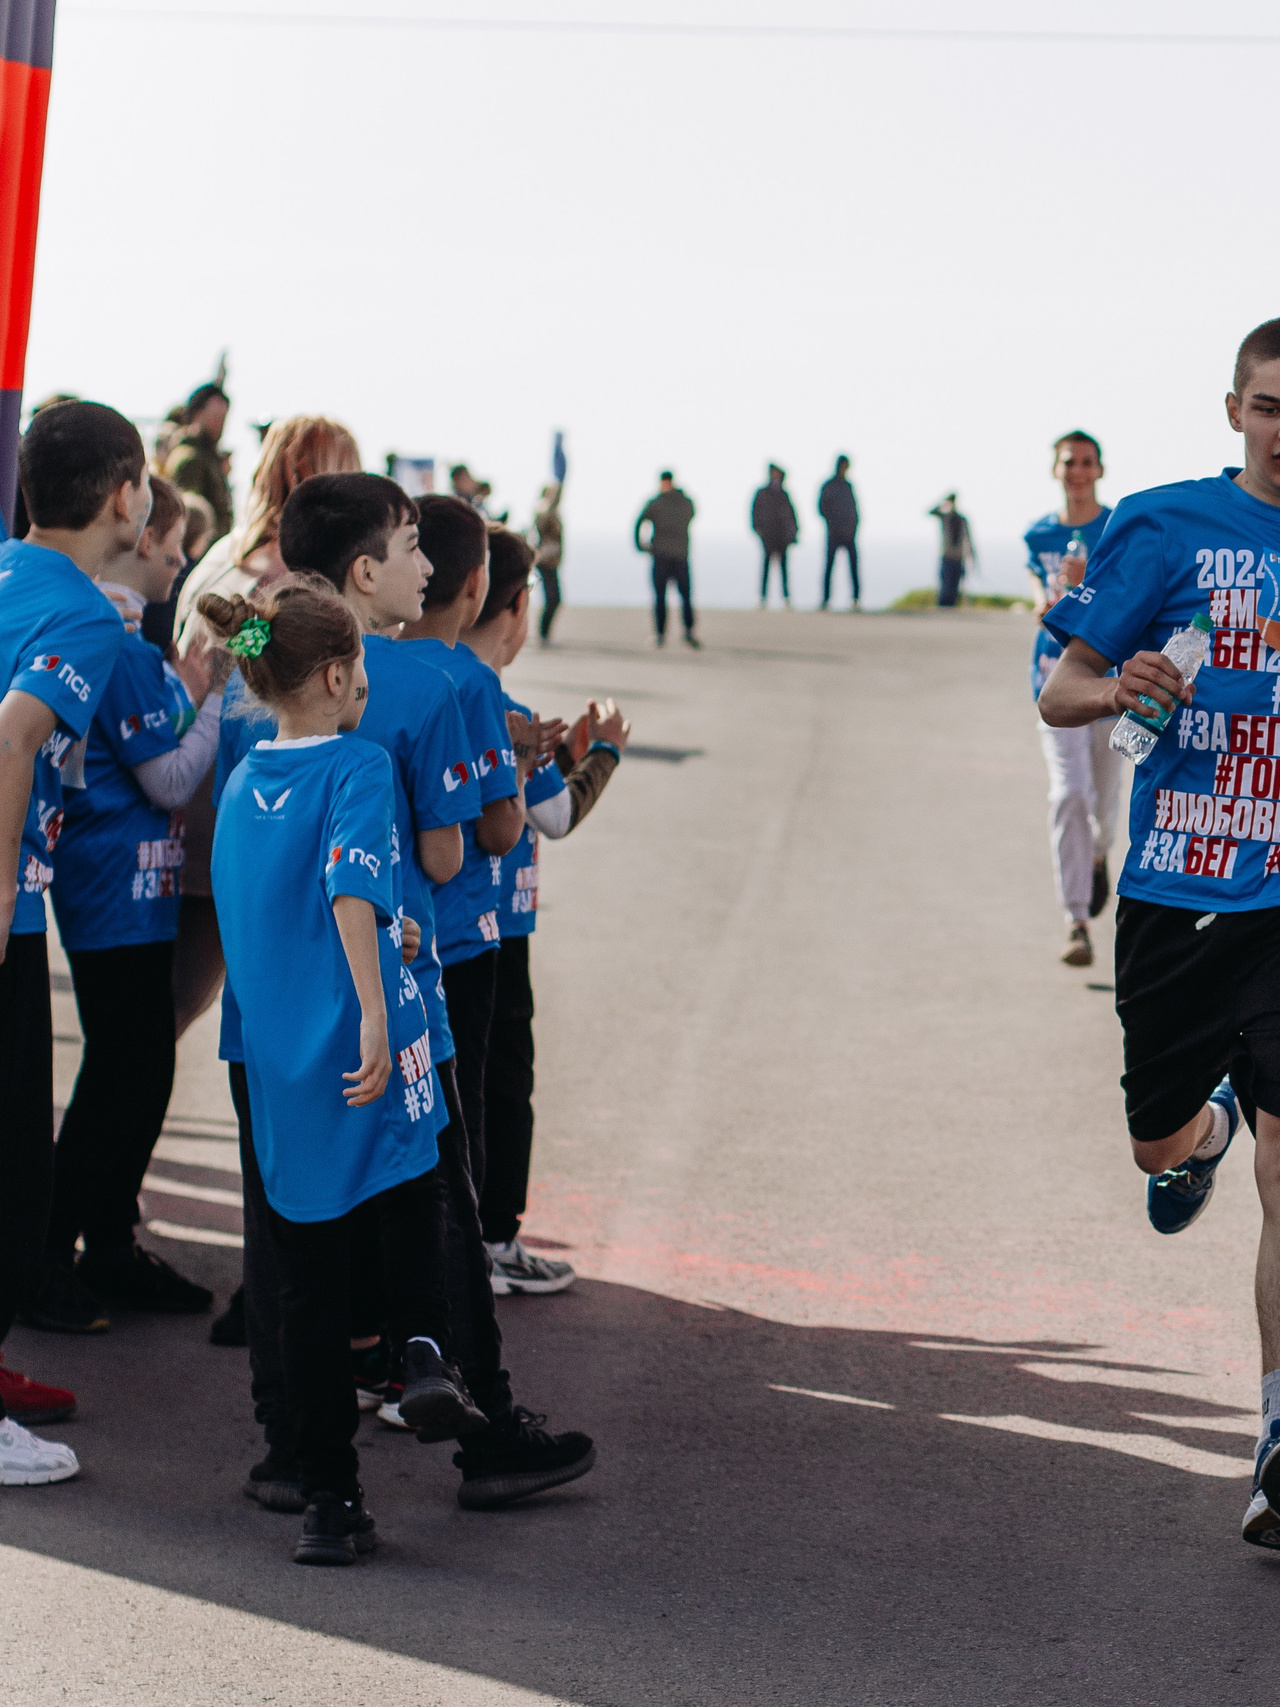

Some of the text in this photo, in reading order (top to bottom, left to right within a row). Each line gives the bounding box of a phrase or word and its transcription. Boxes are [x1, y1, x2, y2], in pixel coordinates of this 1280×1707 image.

[1068, 582, 1097, 605] СБ
[1209, 588, 1262, 629] #М
[57, 663, 92, 703] ПСБ
[1139, 829, 1239, 880] #ЗАБЕГ
